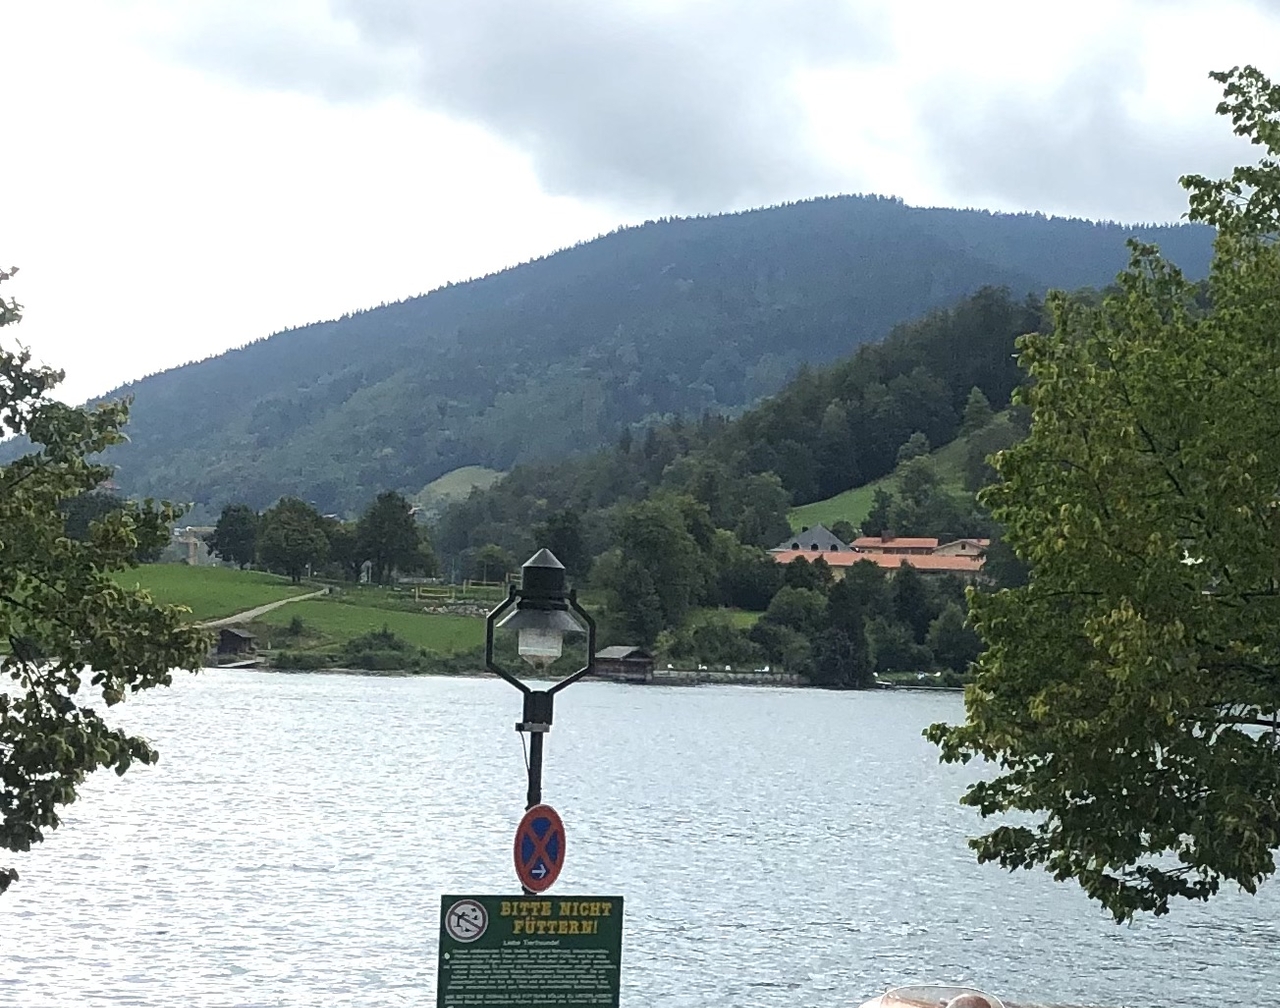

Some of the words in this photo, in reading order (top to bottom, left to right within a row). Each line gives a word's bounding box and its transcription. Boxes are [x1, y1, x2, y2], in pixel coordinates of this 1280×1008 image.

[500, 901, 552, 916] BITTE
[559, 902, 612, 916] NICHT
[512, 916, 598, 935] FÜTTERN!
